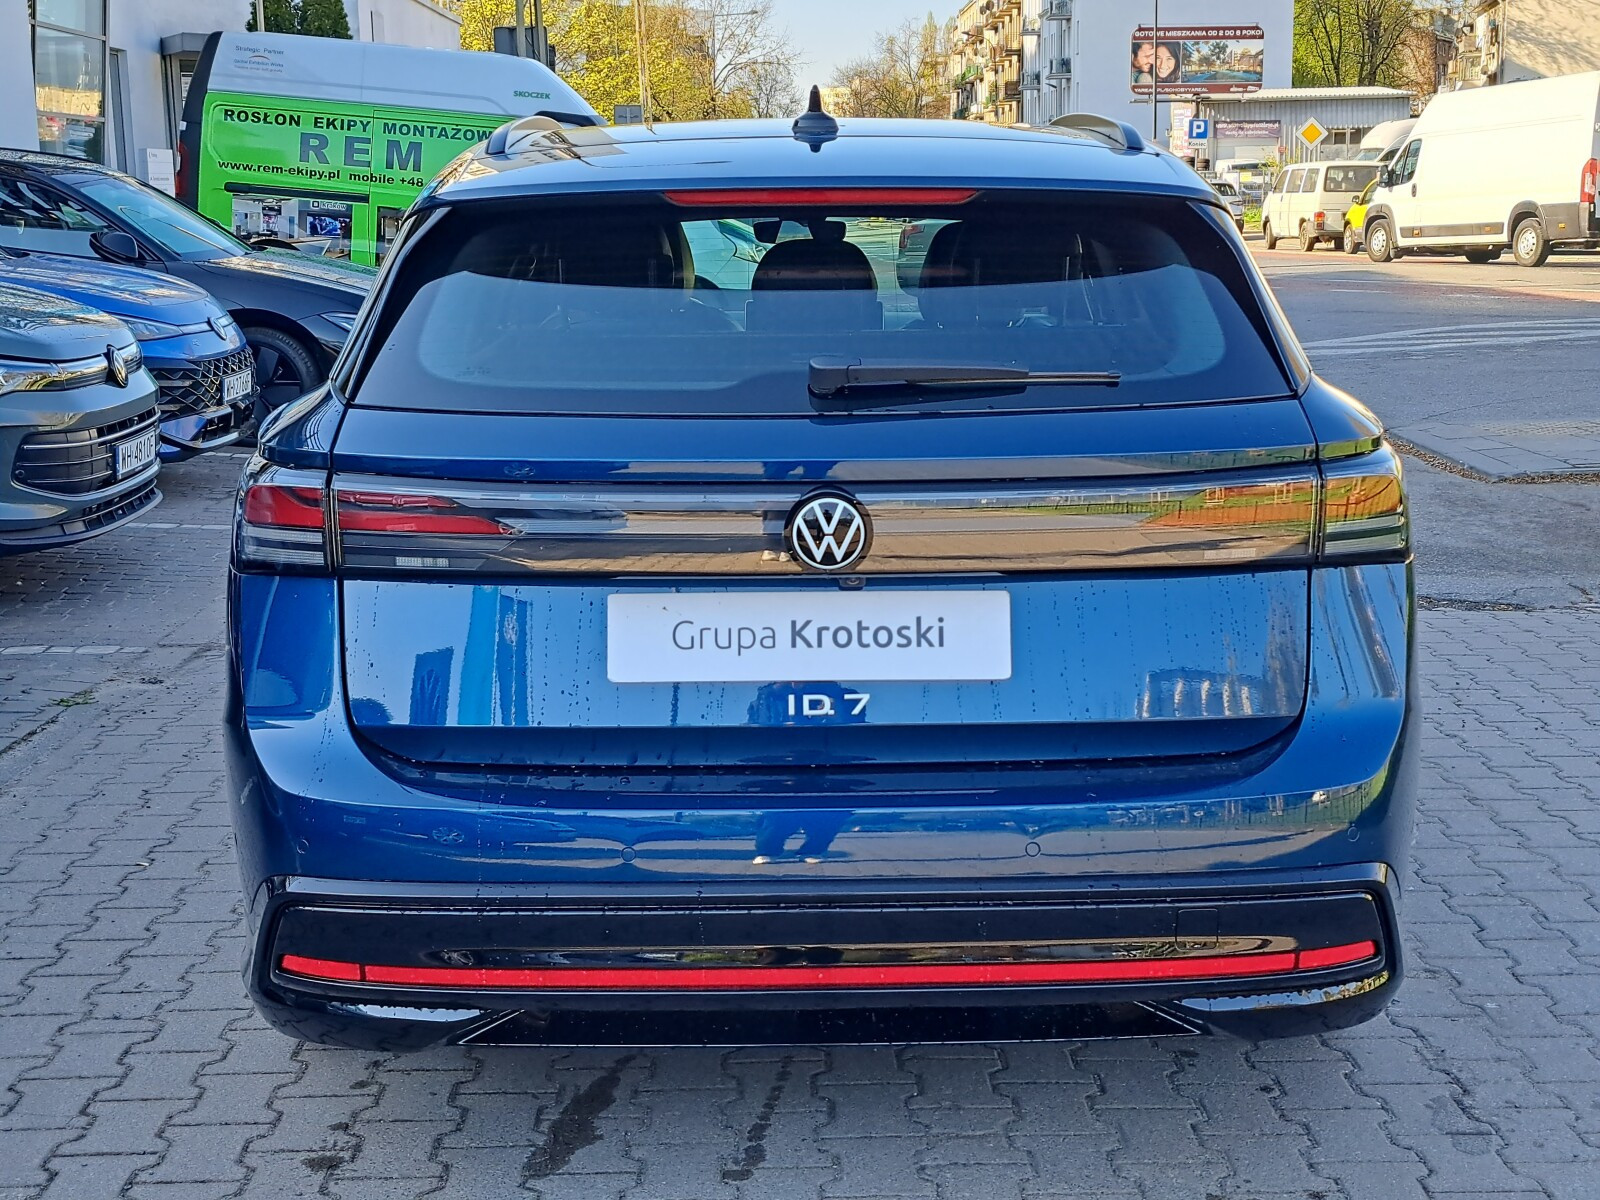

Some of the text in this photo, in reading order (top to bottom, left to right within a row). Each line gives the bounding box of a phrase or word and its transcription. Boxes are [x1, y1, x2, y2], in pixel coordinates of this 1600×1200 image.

[1165, 29, 1206, 37] MIESZKANIA
[513, 90, 551, 99] SKOCZEK
[223, 109, 301, 127] ROSŁON
[313, 117, 372, 132] EKIPY
[1193, 121, 1205, 137] P
[218, 160, 424, 188] www.rem-ekipy.pl mobile +48
[672, 616, 945, 656] Grupa Krotoski
